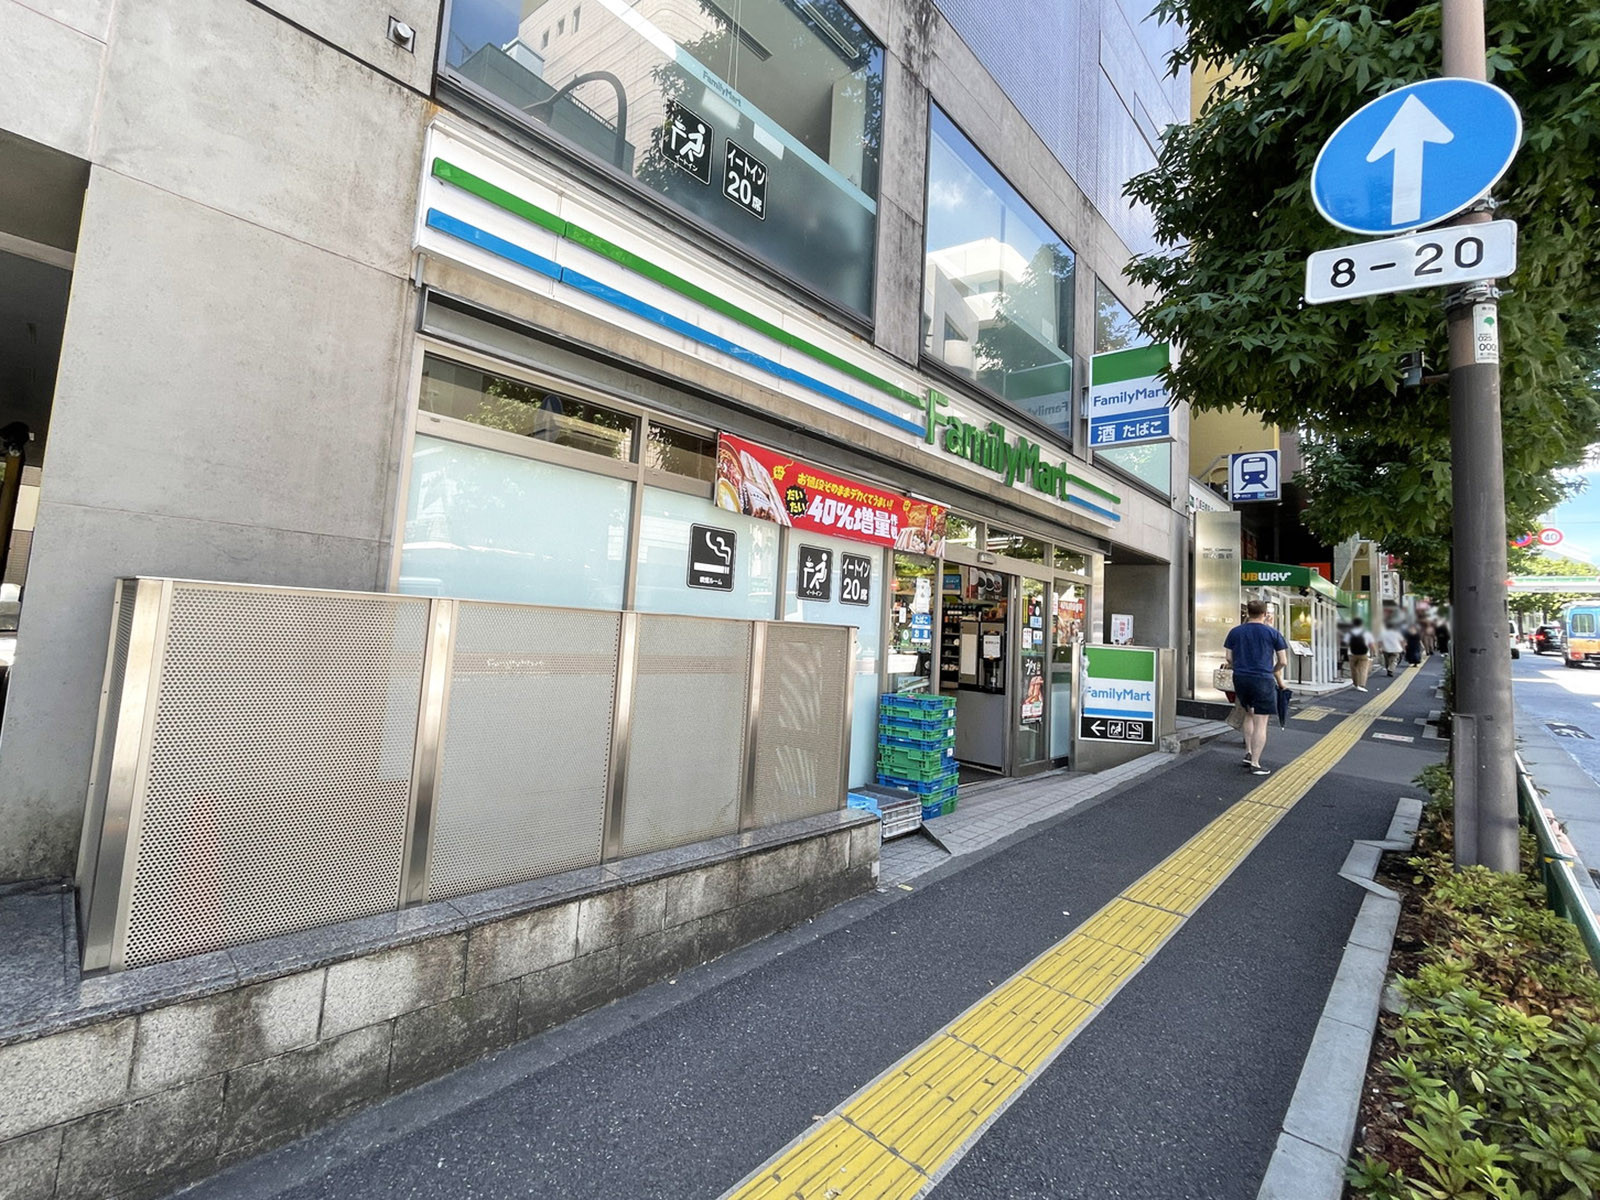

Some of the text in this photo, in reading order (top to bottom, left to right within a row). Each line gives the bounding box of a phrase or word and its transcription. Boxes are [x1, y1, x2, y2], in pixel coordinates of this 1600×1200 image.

[702, 70, 742, 107] FamilyMart
[675, 154, 698, 172] イートイン
[728, 149, 766, 185] イートイン
[727, 171, 762, 212] 20席
[1093, 386, 1168, 407] FamilyMart
[1097, 420, 1162, 442] 酒 たばこ
[926, 388, 1068, 501] FamilyMart
[786, 489, 803, 501] だい
[789, 502, 806, 513] たい
[1544, 533, 1558, 541] 40
[842, 558, 870, 578] イートイン
[1241, 571, 1292, 582] UBWAY
[843, 578, 868, 601] 20席
